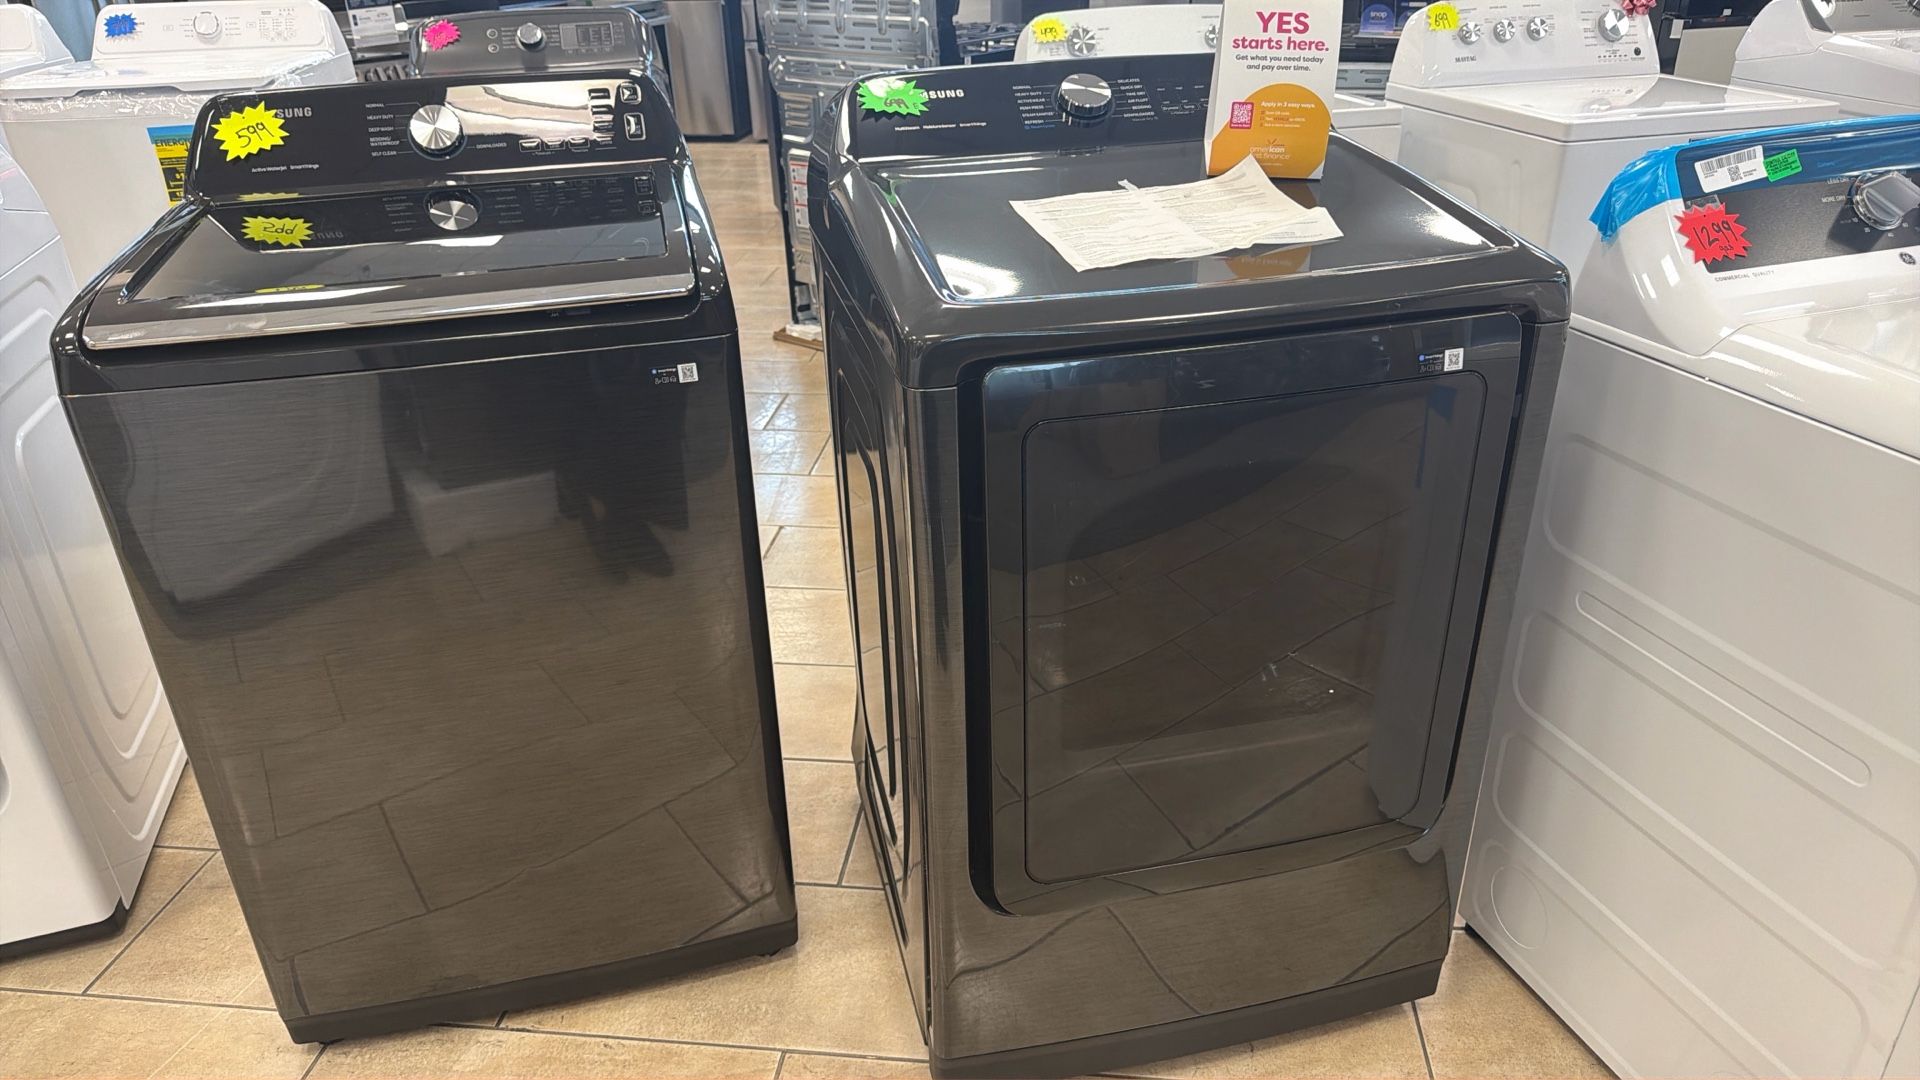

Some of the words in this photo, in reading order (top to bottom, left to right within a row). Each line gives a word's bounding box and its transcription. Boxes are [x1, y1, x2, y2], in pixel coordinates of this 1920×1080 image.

[1256, 11, 1309, 34] YES
[1434, 12, 1451, 29] 699
[1232, 36, 1283, 50] starts
[1287, 36, 1329, 52] here.
[1302, 56, 1324, 64] today
[919, 89, 965, 99] MSUNG
[276, 107, 313, 118] SUNG
[236, 122, 275, 149] 599
[1827, 177, 1840, 185] LESS
[1821, 195, 1836, 203] MORE
[1692, 220, 1738, 250] 1299
[1714, 273, 1750, 282] COMMERCIAL
[1752, 270, 1775, 278] QUALITY
